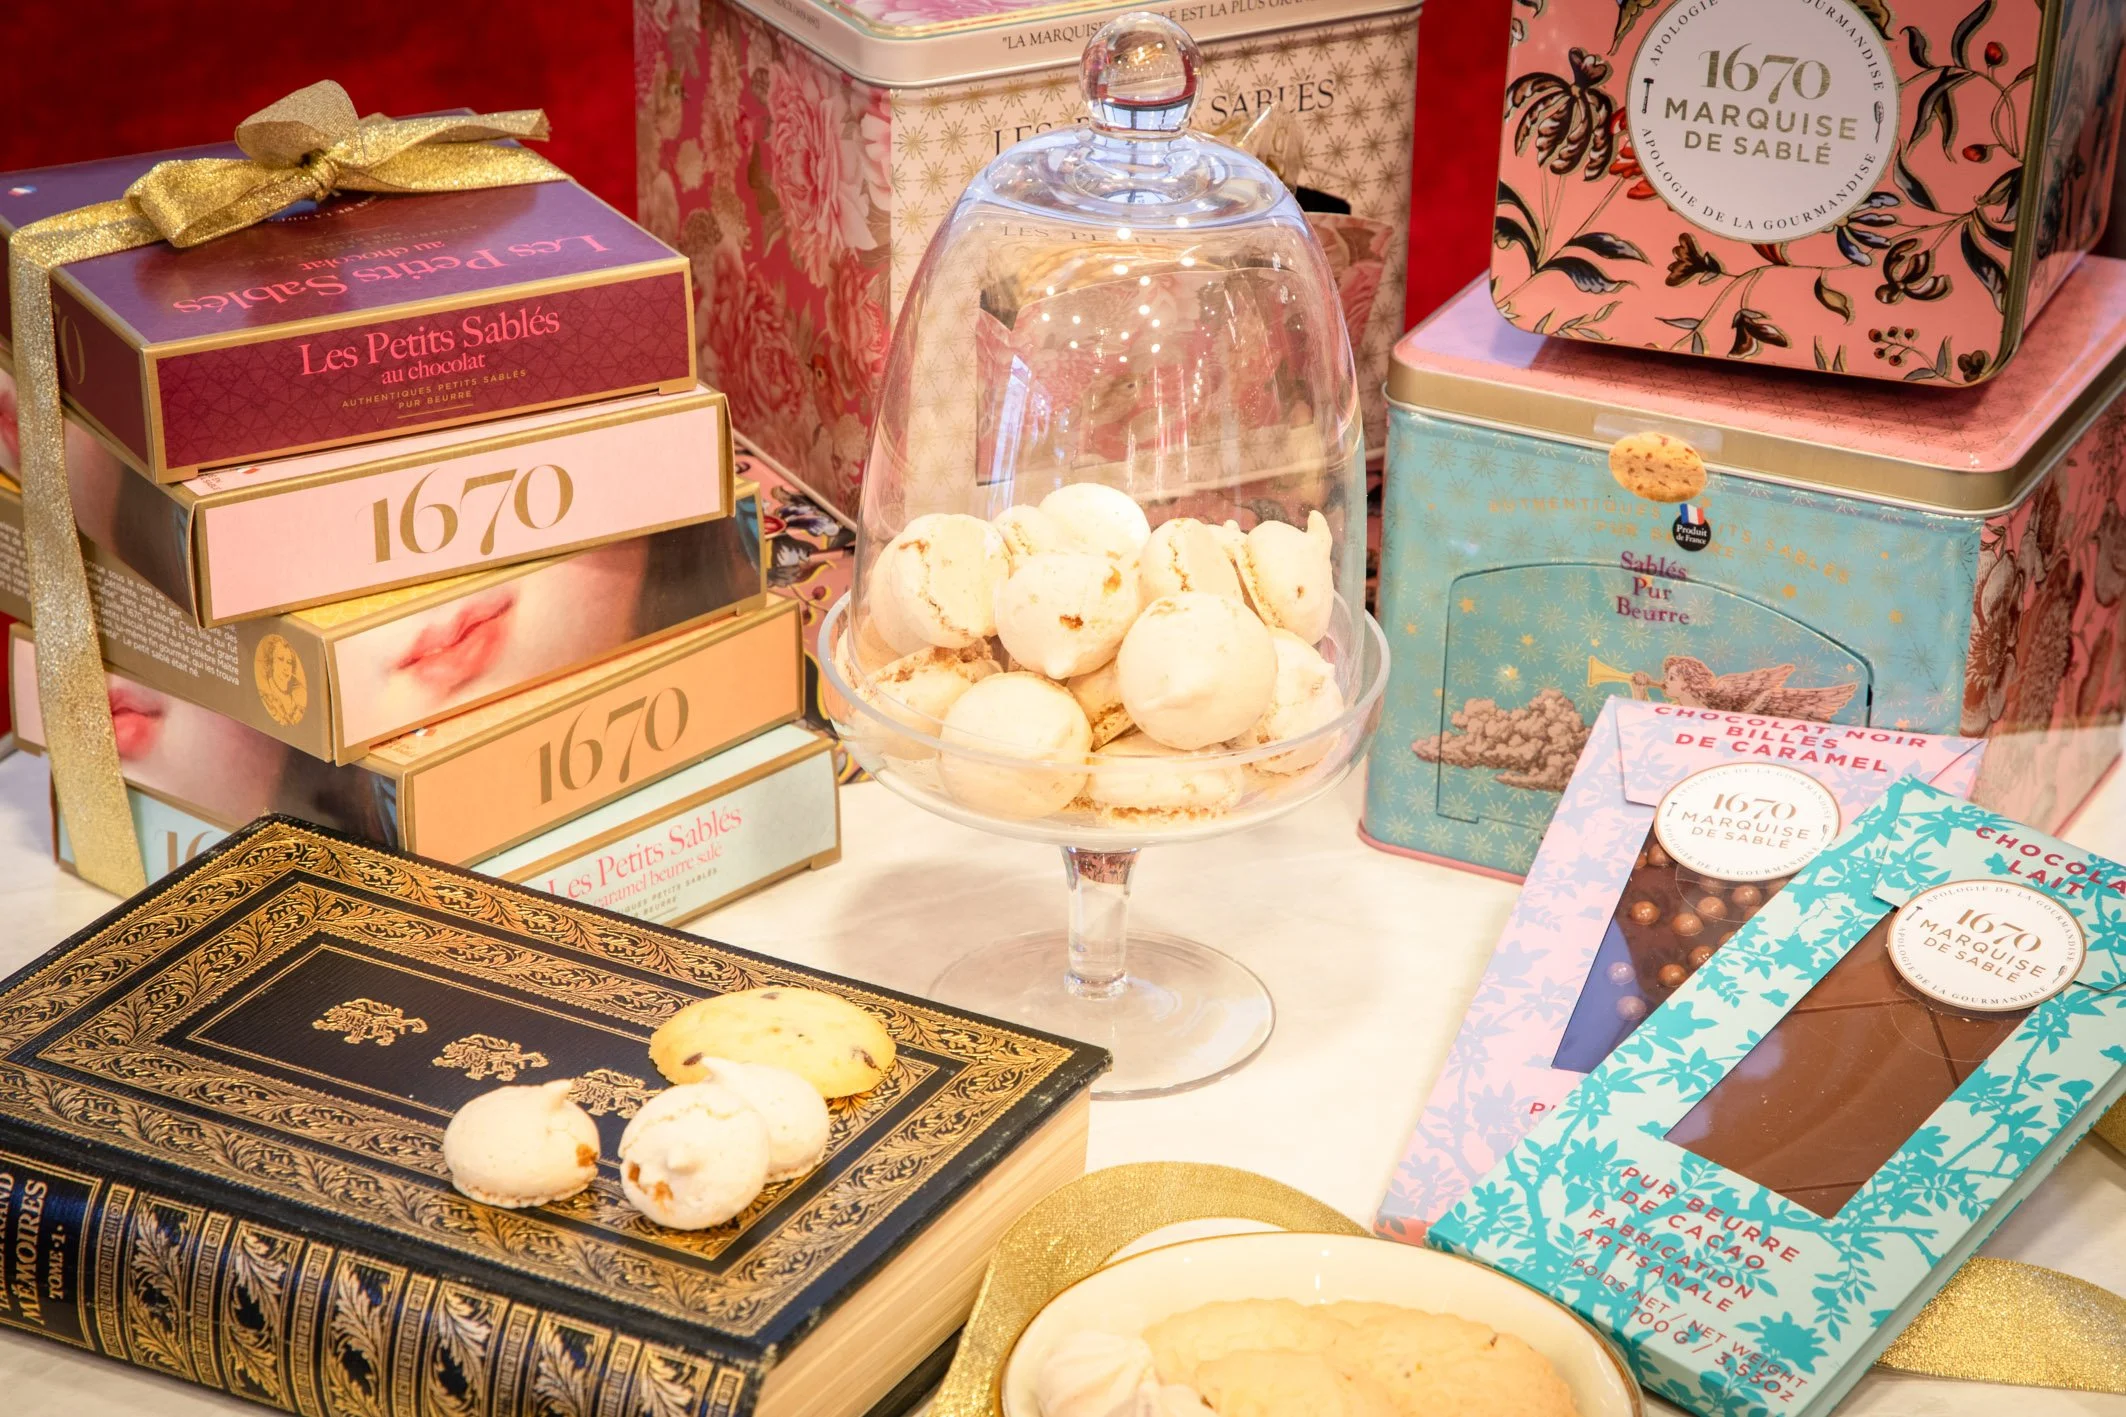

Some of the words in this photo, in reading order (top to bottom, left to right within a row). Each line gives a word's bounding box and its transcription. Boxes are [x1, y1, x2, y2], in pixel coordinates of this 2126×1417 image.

[1181, 5, 1207, 22] EST
[1210, 3, 1227, 17] LA
[1803, 0, 1885, 91] URMANDISE
[1698, 42, 1831, 105] 1670
[1664, 96, 1858, 141] MARQUISE
[1684, 130, 1722, 152] DE
[1733, 136, 1831, 166] SABLÉ
[1641, 127, 1698, 208] APOLOGIE
[1703, 205, 1725, 223] DE
[1733, 216, 1754, 230] LA
[1763, 153, 1876, 231] GOURMANDISE
[300, 245, 409, 271] chocolat
[507, 234, 610, 257] Les
[351, 248, 508, 283] Petits
[172, 274, 347, 313] Sablés
[298, 343, 358, 376] Les
[365, 326, 455, 365] Petits
[462, 306, 560, 348] Sablés
[382, 367, 403, 385] au
[408, 352, 486, 381] chocolat
[342, 385, 432, 408] AUTHENTIQUES
[438, 376, 477, 392] PETITS
[483, 369, 527, 384] SABLÉS
[398, 398, 421, 409] PUR
[427, 390, 473, 406] BEURRE
[355, 463, 574, 563] 1670
[1676, 524, 1707, 537] Produit
[1676, 533, 1684, 541] de
[1685, 535, 1707, 544] France
[1620, 550, 1687, 579] Sablés
[1632, 576, 1672, 600] Pur
[1616, 595, 1690, 625] Beurre
[1654, 706, 1832, 735] CHOCOLAT
[1845, 729, 1927, 748] NOIR
[1726, 726, 1839, 749] BILLES
[524, 686, 689, 809] 1670
[1675, 733, 1717, 748] DE
[1731, 741, 1888, 772] CARAMEL
[1681, 811, 1811, 840] MARQUISE
[1713, 792, 1797, 821] 1670
[597, 843, 664, 888] Petits
[669, 805, 743, 856] Sablés
[1691, 826, 1717, 838] DE
[1724, 832, 1791, 849] SABLÉ
[650, 859, 696, 886] beurre
[2008, 859, 2086, 895] LAIT
[1919, 919, 2047, 979] MARQUISE
[1956, 908, 2042, 953] 1670
[1923, 936, 1952, 954] DE
[1954, 949, 2021, 984] SABLÉ
[1619, 1190, 1660, 1216] DE
[1667, 1213, 1766, 1270] CACAO
[1620, 1166, 1677, 1200] PUR
[1685, 1197, 1801, 1264] BEURRE
[11, 1178, 48, 1326] MÉMOIRES
[1578, 1227, 1734, 1313] ARTISANALE
[1588, 1208, 1754, 1301] FABRICATION
[48, 1250, 65, 1300] TOME
[1571, 1257, 1627, 1293] POIDS
[1632, 1290, 1671, 1315] NET
[1688, 1319, 1728, 1344] NET
[1732, 1341, 1808, 1389] WEIGHT
[1629, 1305, 1671, 1334] 100
[1672, 1330, 1694, 1346] G
